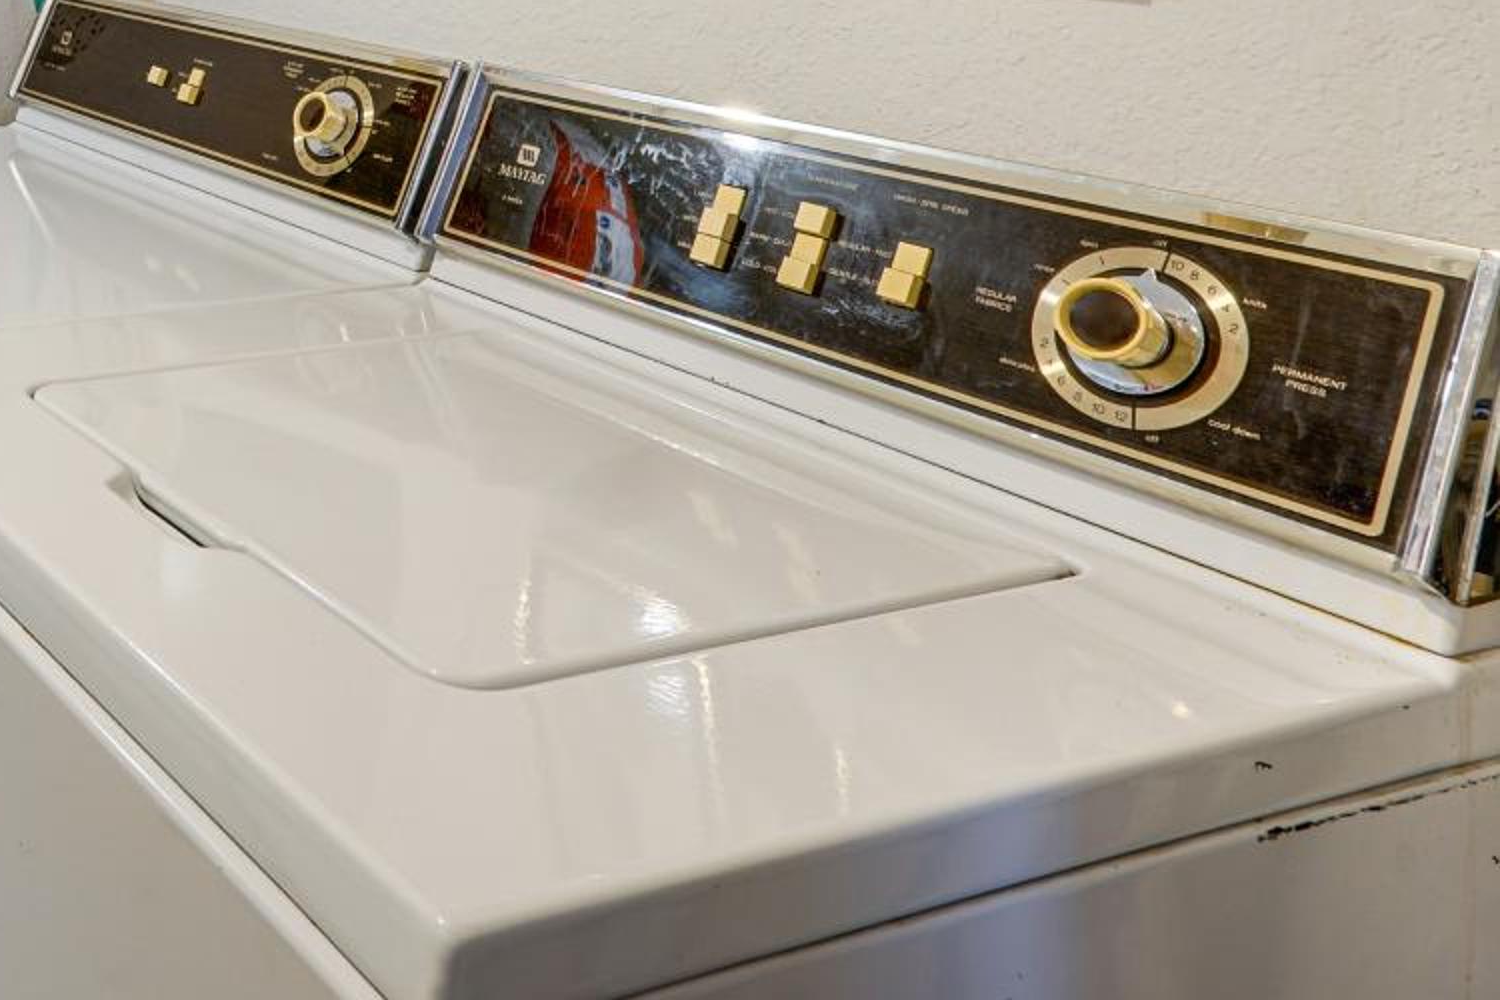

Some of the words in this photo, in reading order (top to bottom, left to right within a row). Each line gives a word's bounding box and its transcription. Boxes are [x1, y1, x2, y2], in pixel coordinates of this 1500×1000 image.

[497, 163, 547, 185] MAYTAG
[1171, 260, 1184, 272] 10
[1189, 270, 1200, 282] 8
[975, 286, 1017, 303] REGULAR
[1207, 285, 1217, 296] 6
[1228, 323, 1239, 335] 2
[1271, 363, 1348, 391] PERMANENT
[1285, 379, 1328, 398] PRESS
[1092, 404, 1105, 415] 10
[1114, 410, 1128, 422] 12
